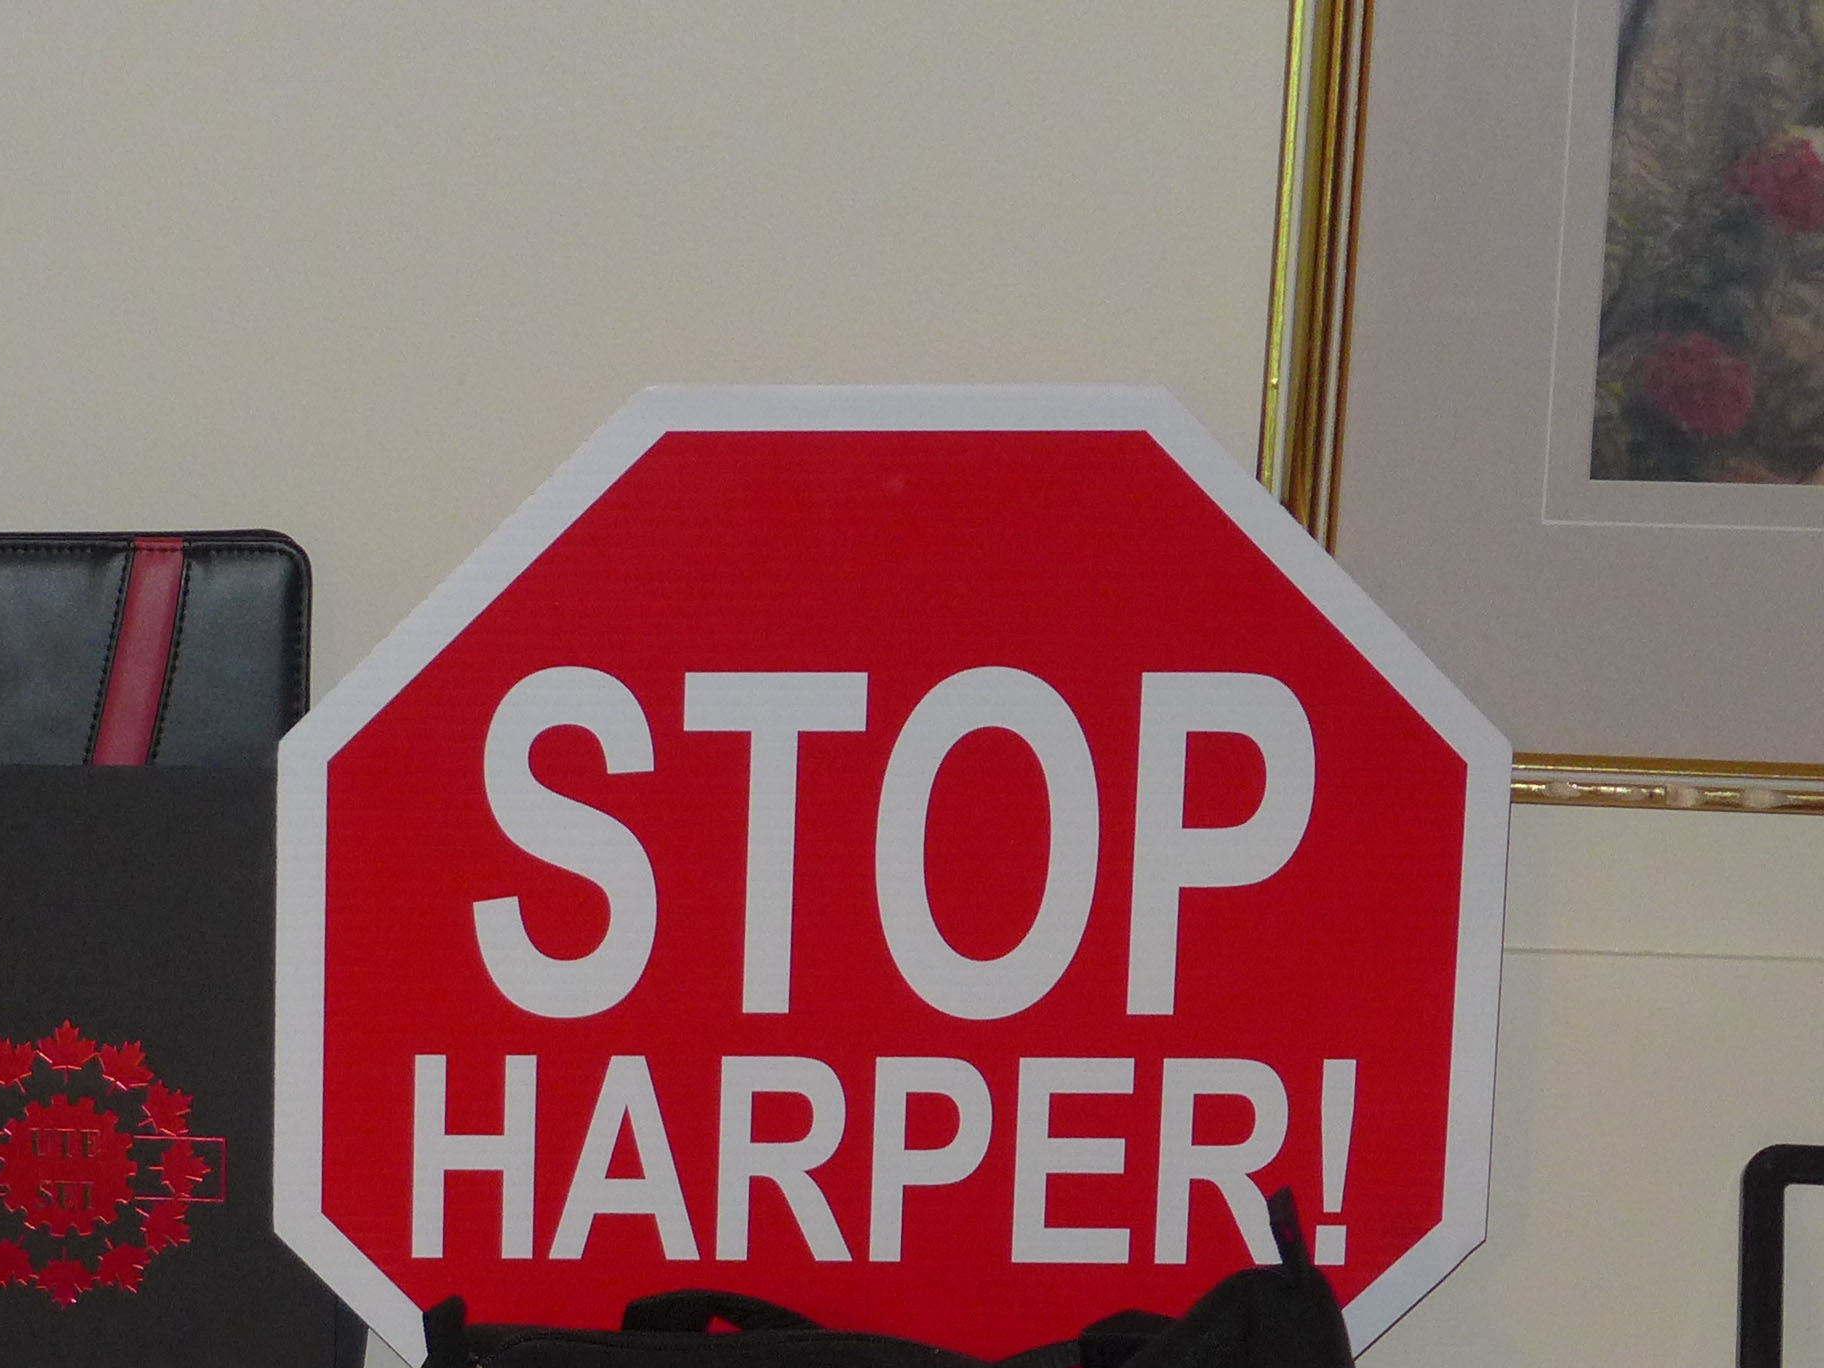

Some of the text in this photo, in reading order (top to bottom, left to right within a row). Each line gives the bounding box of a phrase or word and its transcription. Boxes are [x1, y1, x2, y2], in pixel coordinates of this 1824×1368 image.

[472, 665, 1317, 1020] STOP
[30, 1127, 101, 1158] UTE
[35, 1179, 94, 1210] SEI
[409, 1053, 1358, 1267] HARPER!
